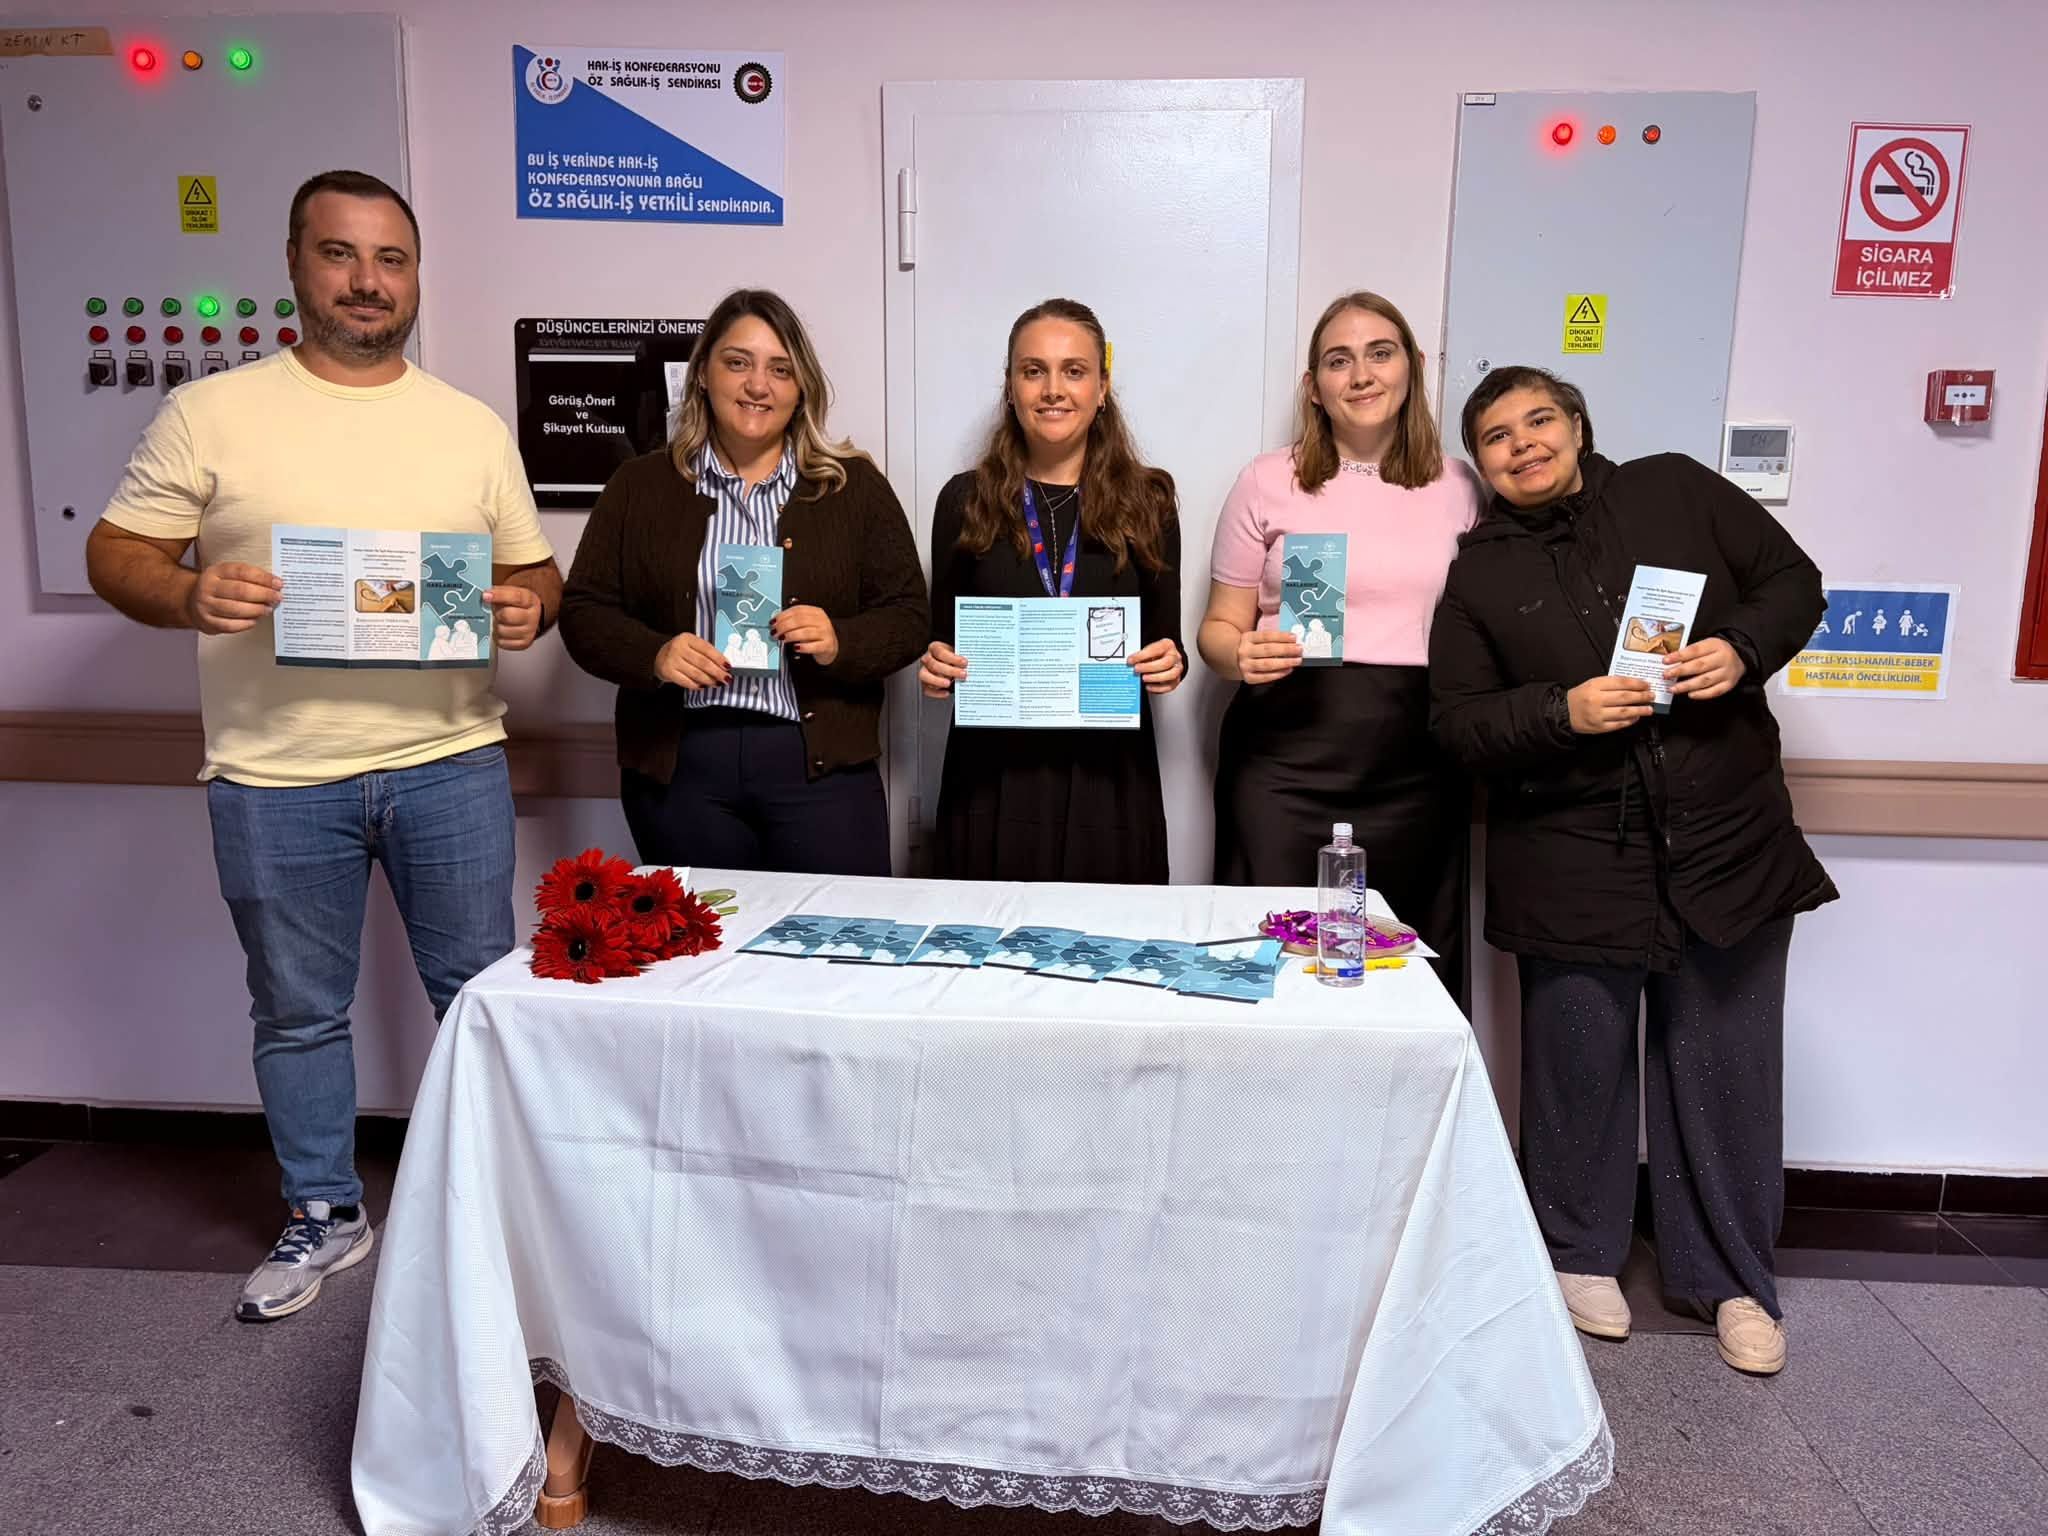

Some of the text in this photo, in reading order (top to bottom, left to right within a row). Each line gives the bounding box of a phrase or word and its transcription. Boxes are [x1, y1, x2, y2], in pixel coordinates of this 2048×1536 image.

[588, 58, 720, 74] HAK-İŞ KONFEDERASYONU
[588, 73, 721, 90] ÖZ SAĞLIK-İŞ SENDİKASI
[528, 152, 658, 172] BU İŞ YERİNDE HAK-İŞ
[528, 172, 702, 188] KONFEDERASYONUNA BAĞLI
[528, 188, 775, 214] ÖZ SAĞLIK-İŞ YETKİLİ SENDİKADIR.
[1860, 243, 1934, 264] SİGARA
[1856, 266, 1933, 288] İÇİLMEZ
[536, 320, 654, 336] DÜŞÜNCELERİNİZİ
[576, 411, 589, 420] ve
[543, 422, 625, 435] Şikayet Kutusu
[1806, 671, 1854, 680] HASTALAR
